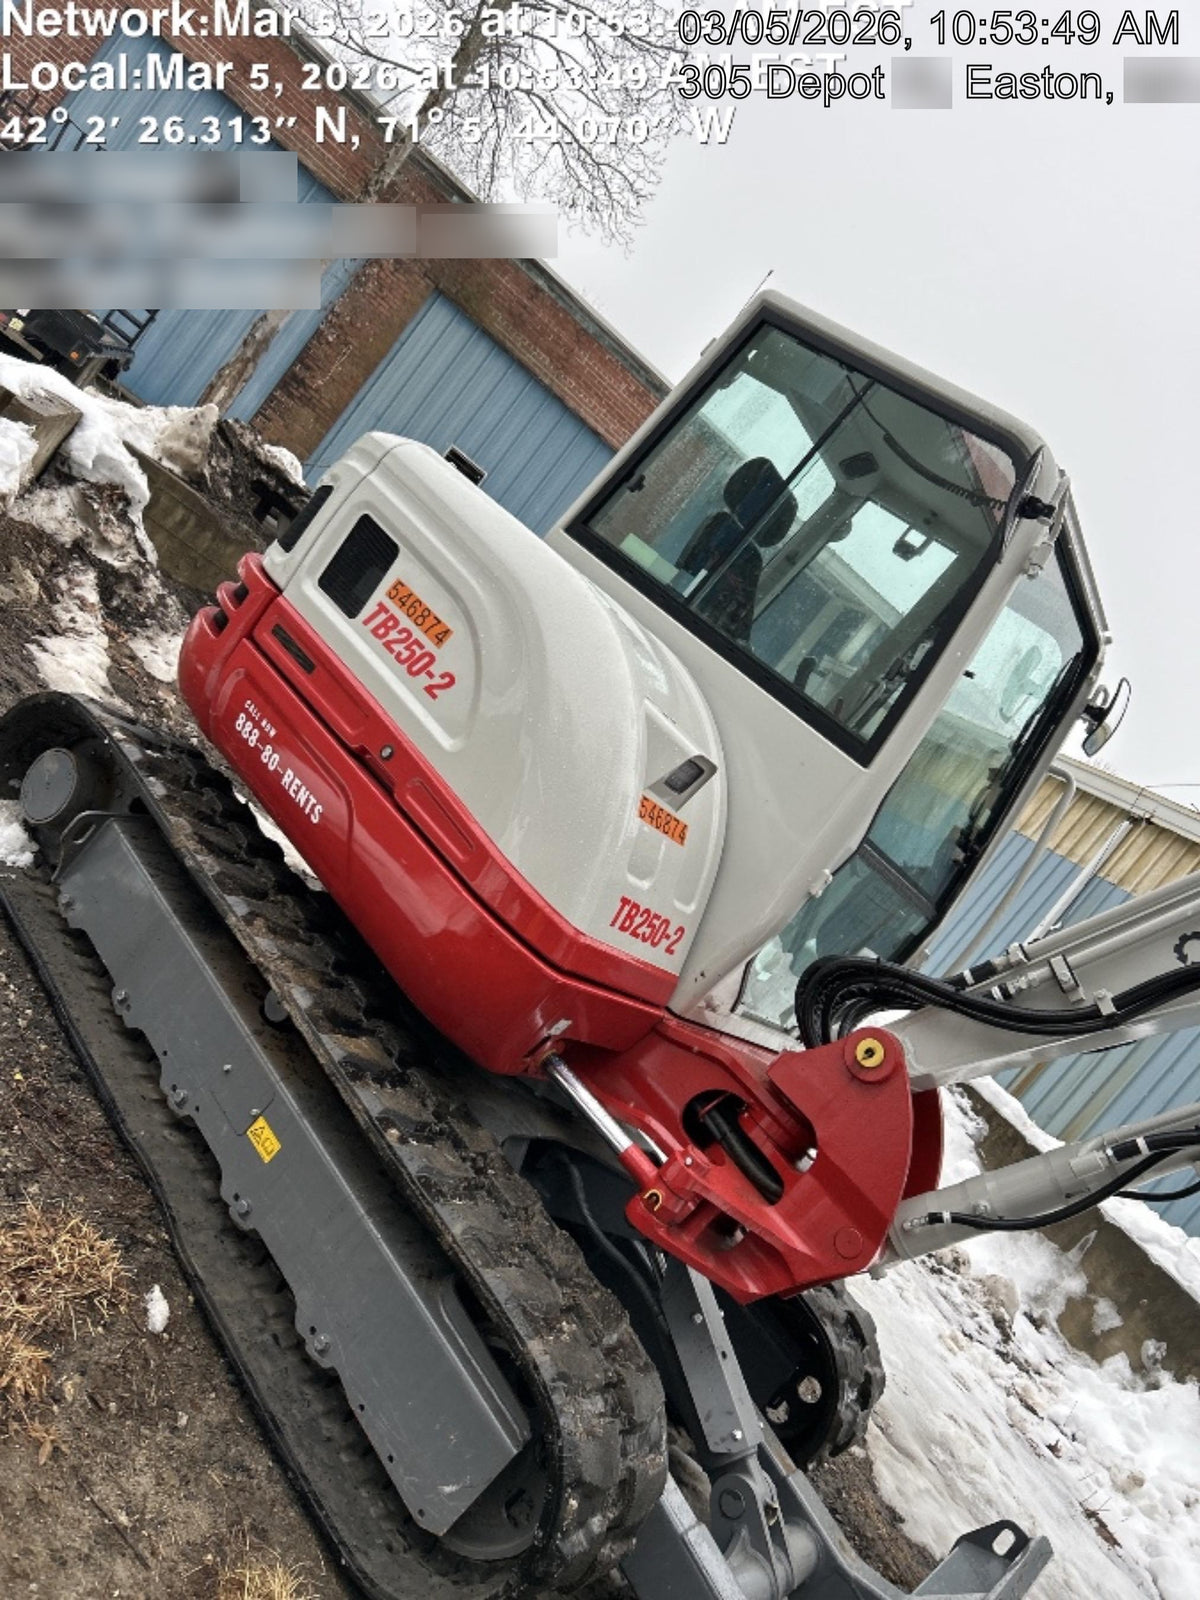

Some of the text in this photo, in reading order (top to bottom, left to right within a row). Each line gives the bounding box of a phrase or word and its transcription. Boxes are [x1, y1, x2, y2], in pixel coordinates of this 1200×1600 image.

[387, 582, 451, 647] 546874
[362, 602, 456, 700] TB250-2
[235, 712, 323, 824] 888-80-RENTS
[638, 795, 689, 843] 546874
[609, 895, 686, 956] TB250-2
